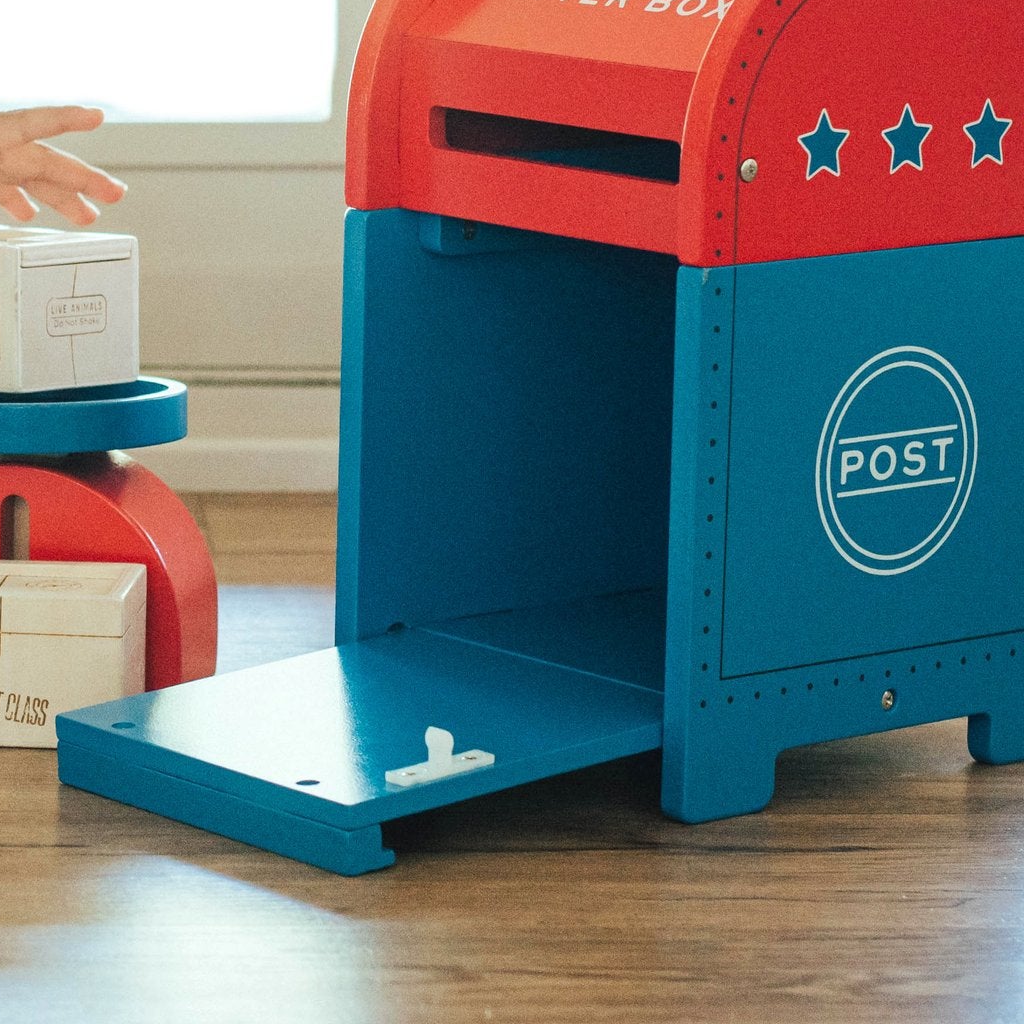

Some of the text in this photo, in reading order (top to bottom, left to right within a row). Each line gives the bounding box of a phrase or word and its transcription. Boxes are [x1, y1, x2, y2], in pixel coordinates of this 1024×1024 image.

[50, 301, 102, 315] LIVE ANIMALS
[840, 437, 954, 485] POST
[5, 693, 50, 727] CLASS
